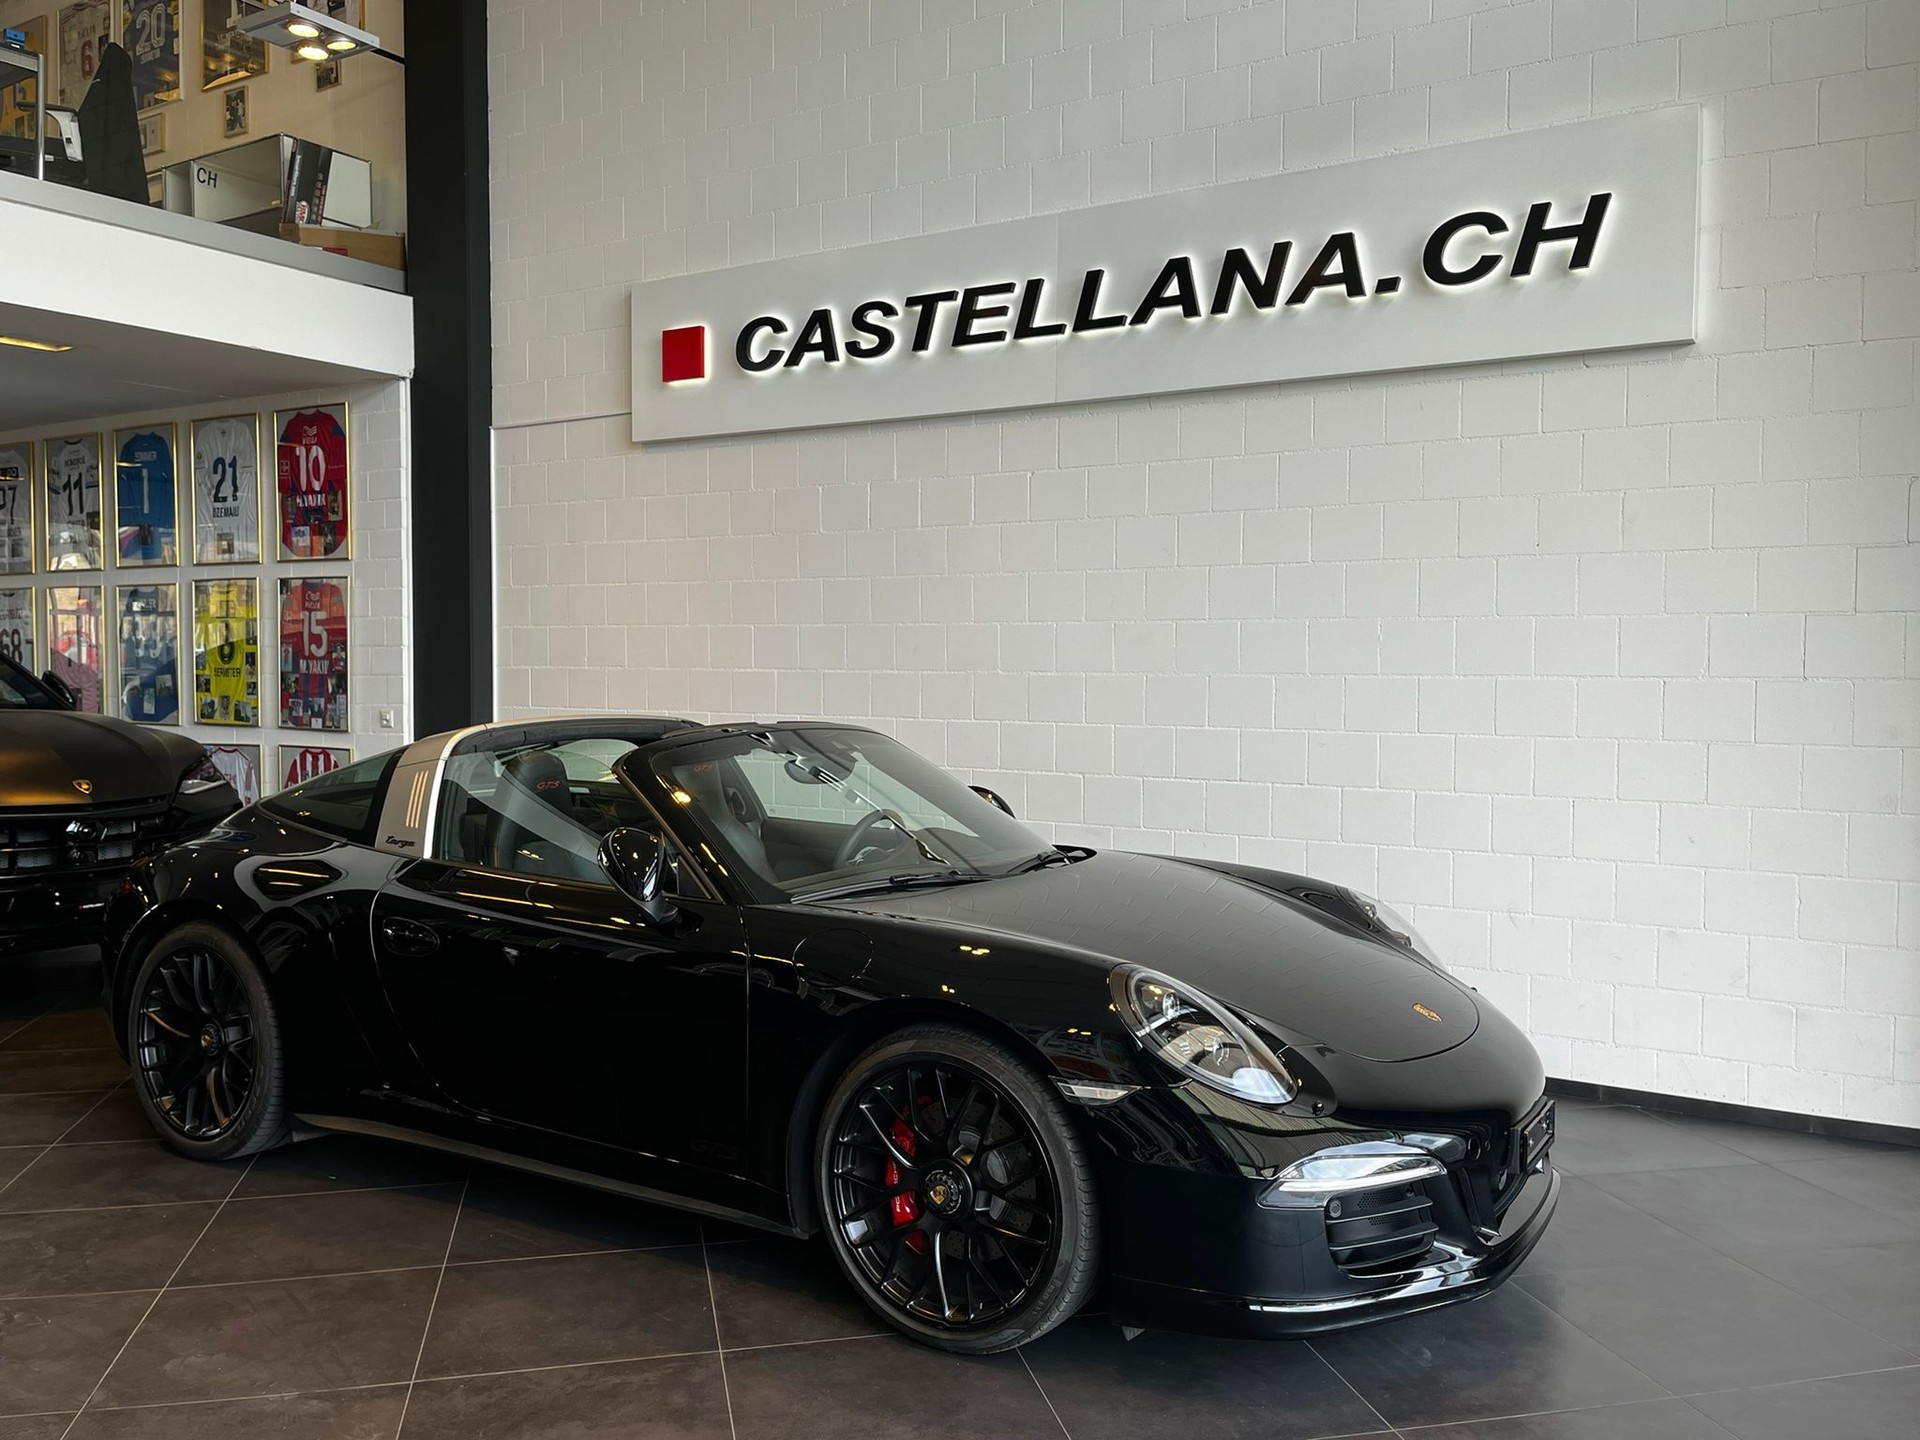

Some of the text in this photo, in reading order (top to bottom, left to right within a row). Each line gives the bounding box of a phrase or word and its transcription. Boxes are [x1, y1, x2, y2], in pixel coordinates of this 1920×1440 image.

[136, 3, 166, 56] 20
[197, 167, 217, 188] CH
[735, 192, 1612, 373] CASTELLANA.CH
[213, 456, 239, 503] 21
[296, 446, 326, 492] 10
[62, 472, 84, 516] 11
[301, 611, 328, 658] 15
[536, 780, 560, 790] GTS
